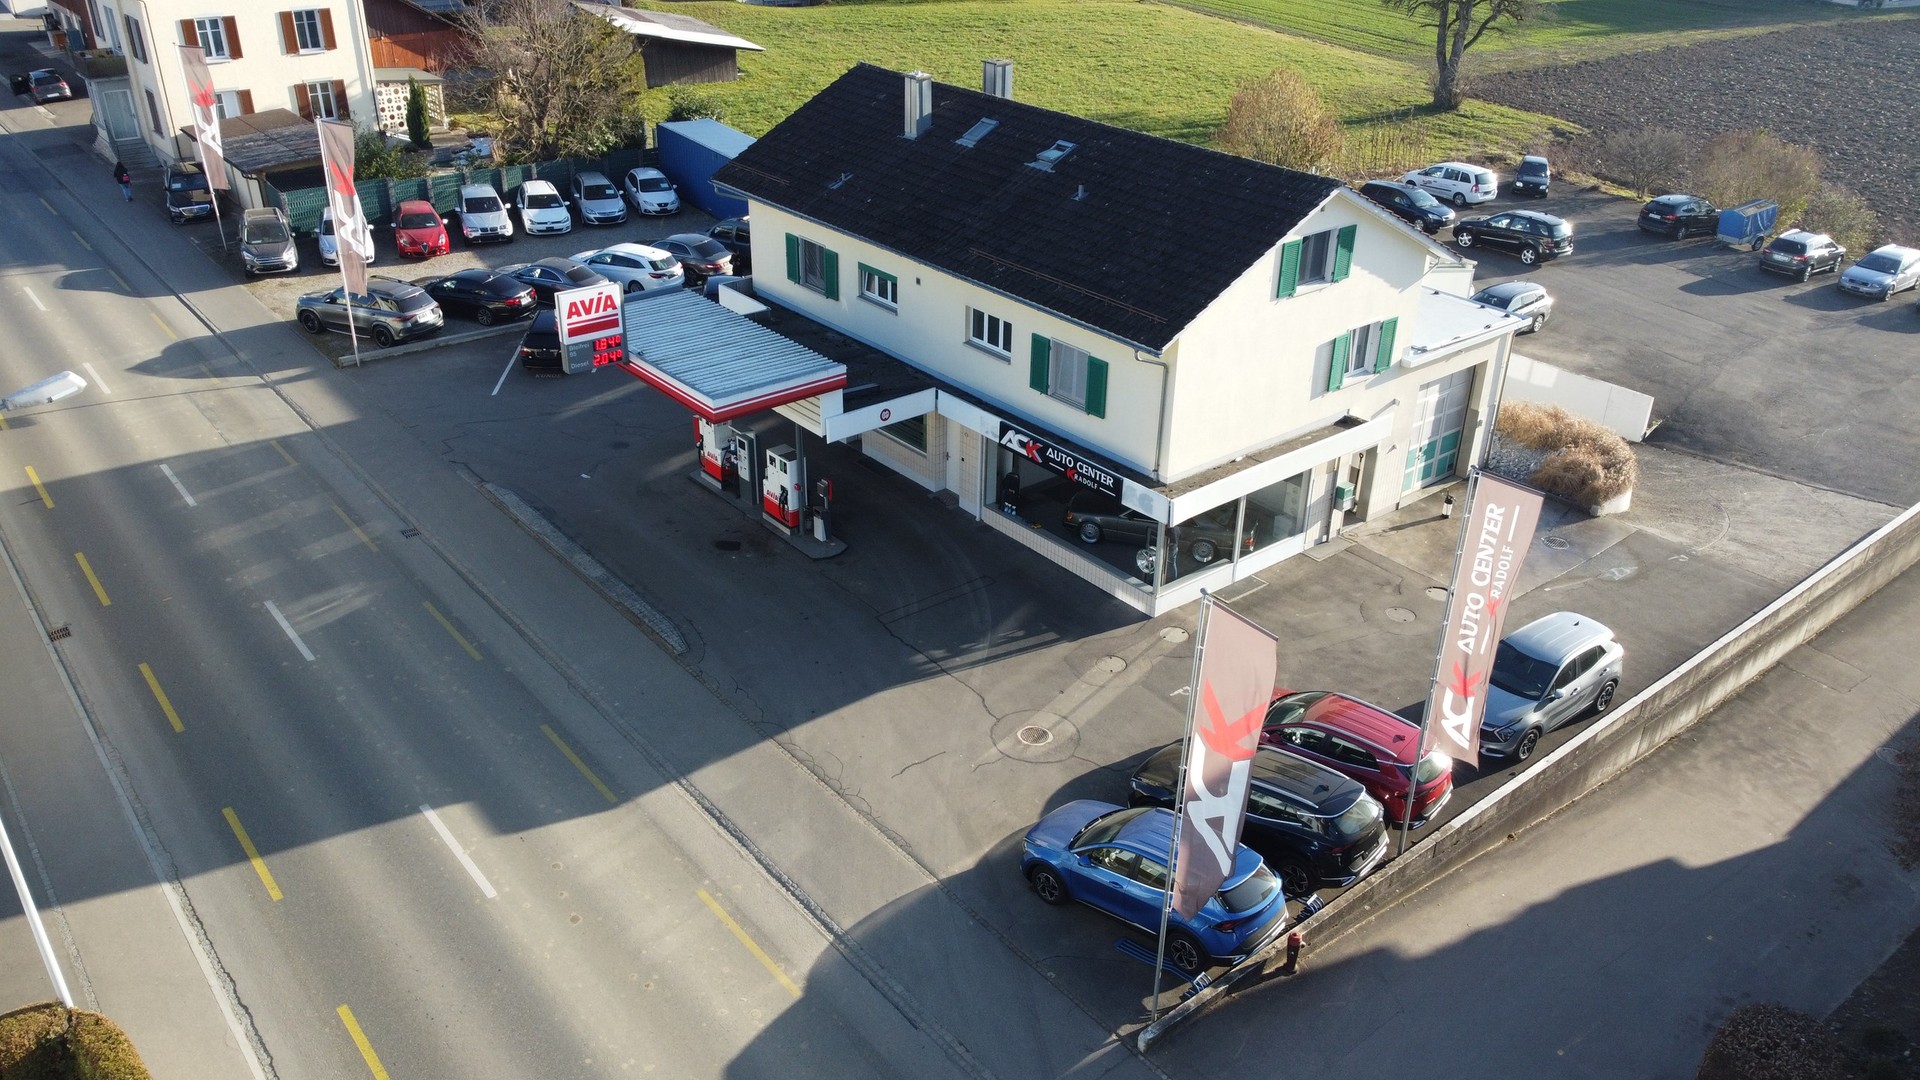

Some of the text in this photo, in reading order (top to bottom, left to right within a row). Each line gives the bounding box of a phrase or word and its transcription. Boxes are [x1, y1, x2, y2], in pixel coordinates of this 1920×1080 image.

[570, 361, 590, 369] Diesel
[1000, 429, 1114, 488] ACK AUTO CENTER
[1470, 502, 1506, 588] CENTER
[1456, 592, 1485, 656] AUTO
